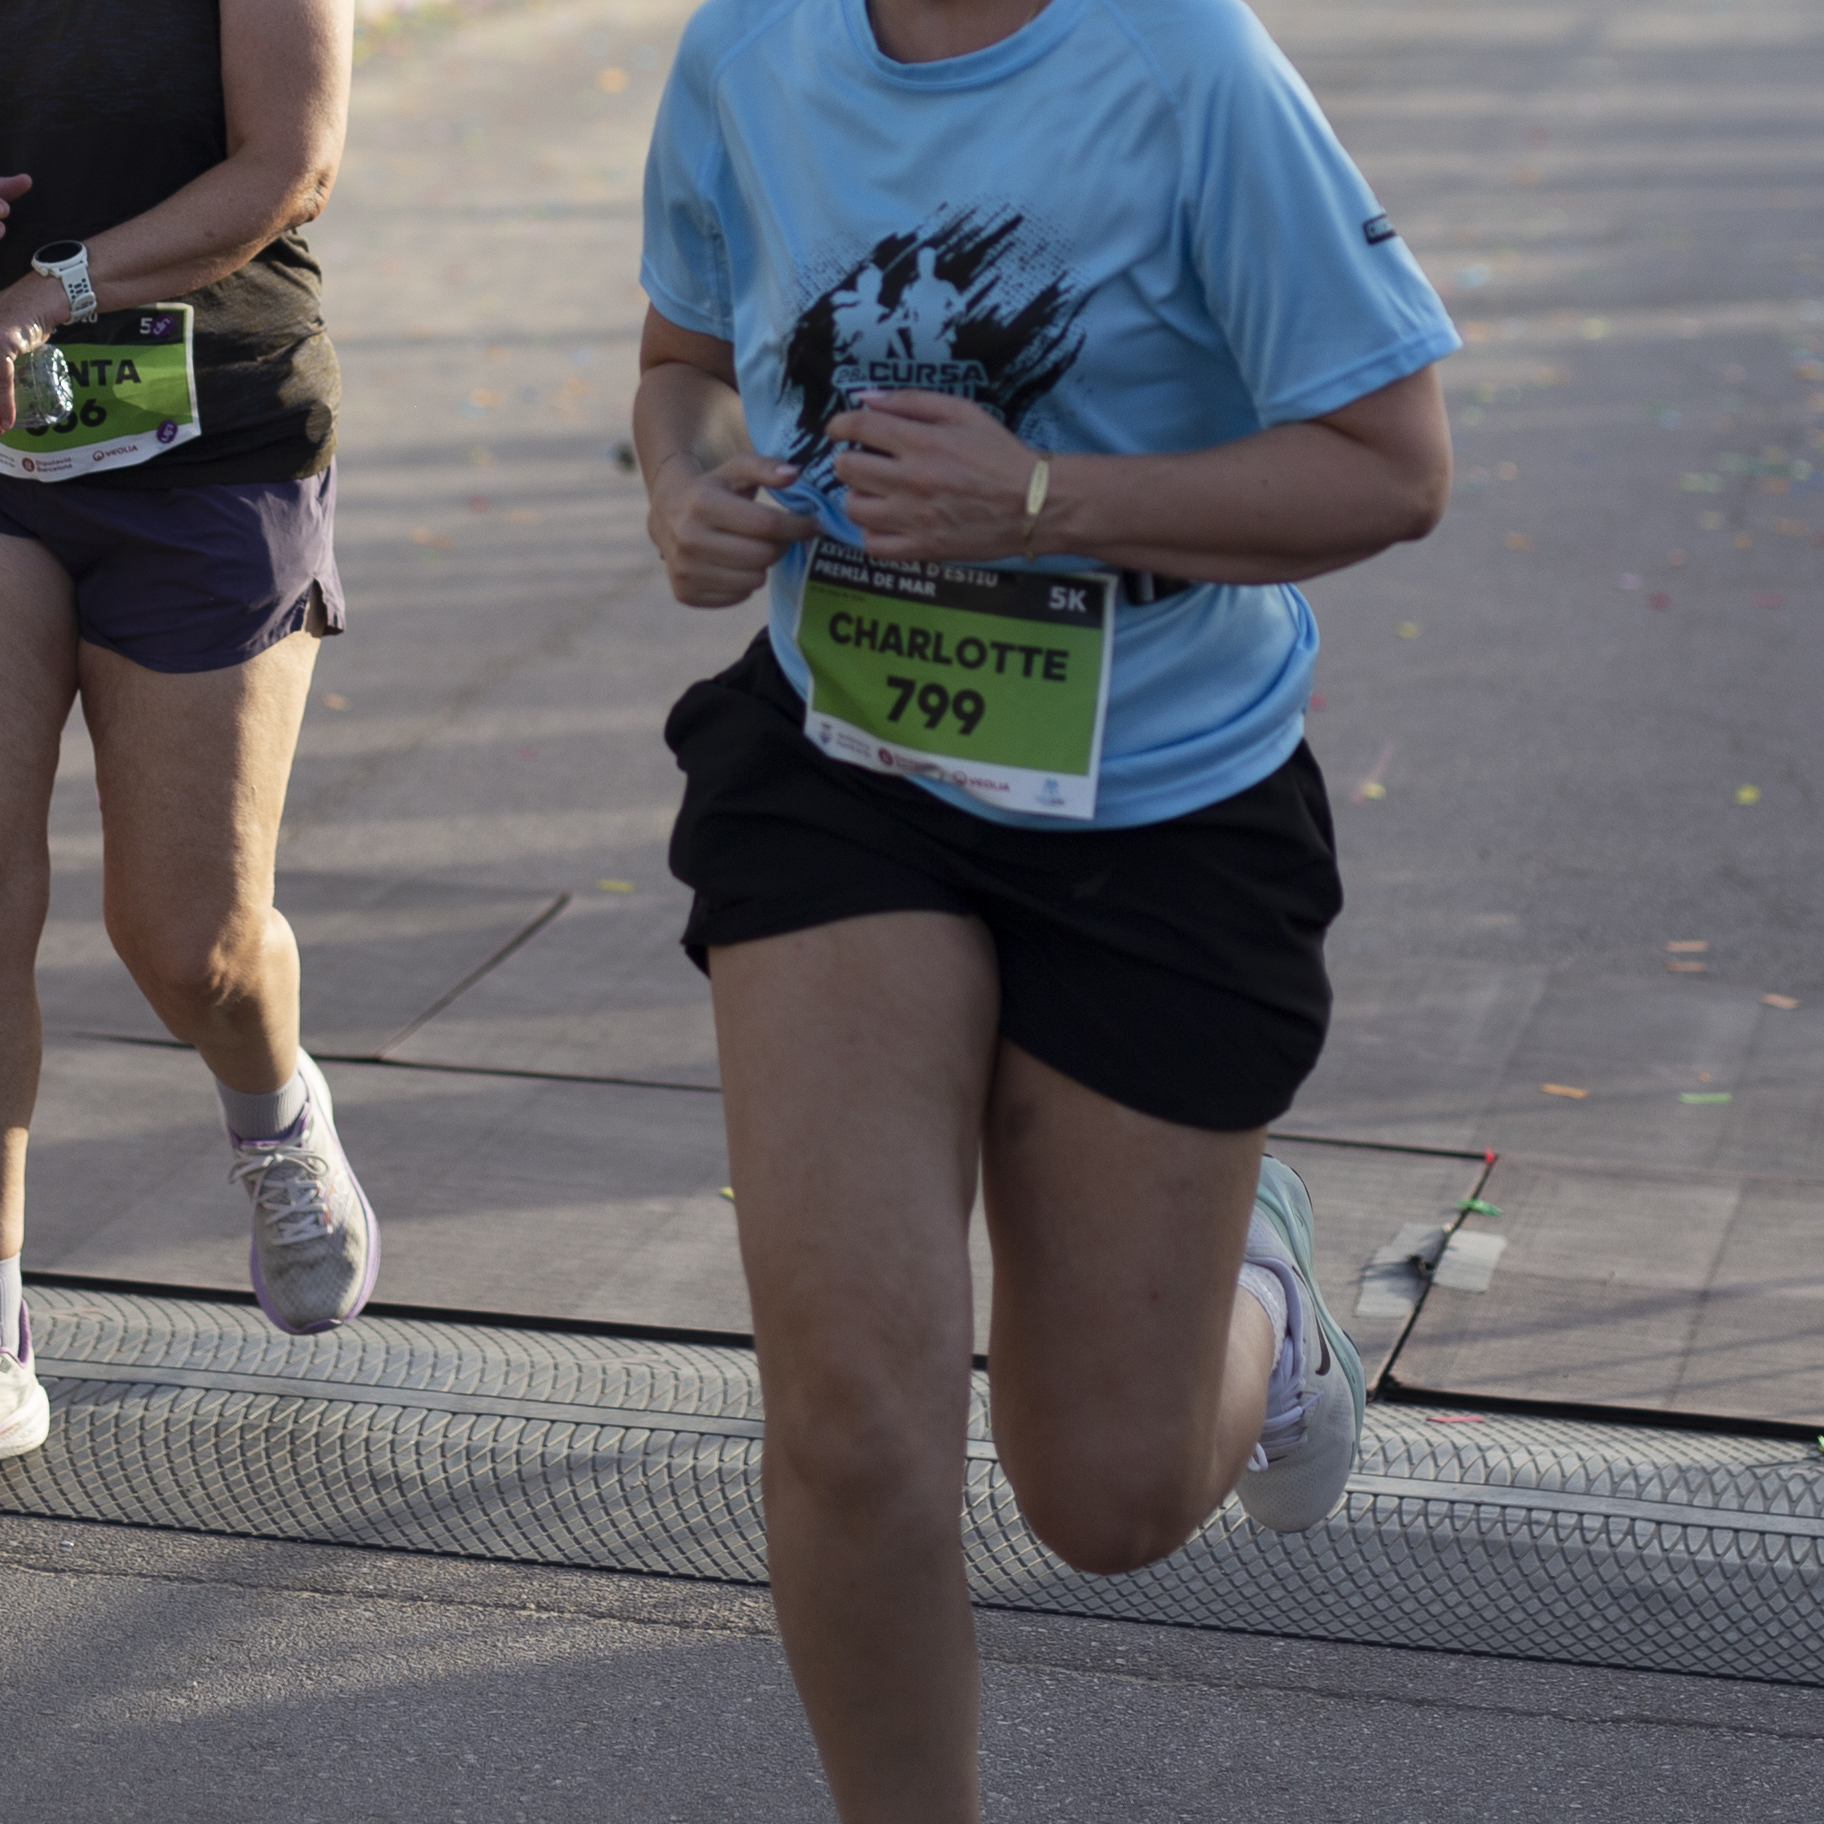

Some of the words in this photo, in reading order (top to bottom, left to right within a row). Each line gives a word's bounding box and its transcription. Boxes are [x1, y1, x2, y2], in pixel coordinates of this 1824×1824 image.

[67, 358, 142, 388] NTA
[869, 361, 985, 385] CURSA
[105, 444, 139, 457] VEOLIA
[872, 571, 896, 590] DE
[898, 576, 937, 597] MAR
[1048, 585, 1088, 614] 5K
[828, 611, 1070, 683] CHARLOTTE
[885, 676, 987, 737] 799
